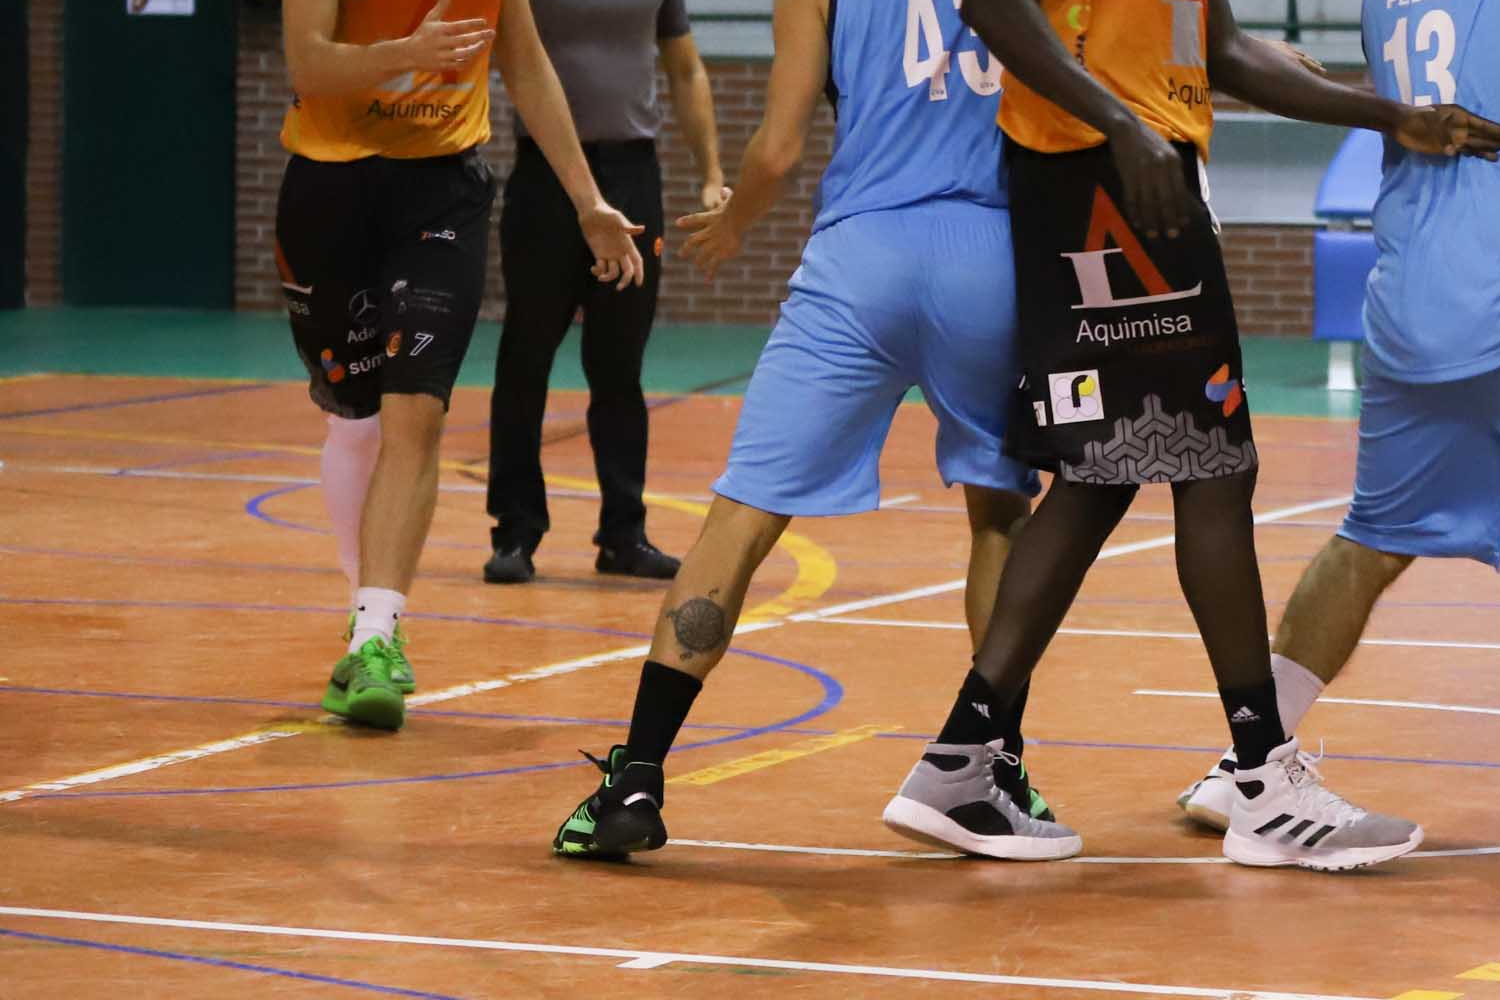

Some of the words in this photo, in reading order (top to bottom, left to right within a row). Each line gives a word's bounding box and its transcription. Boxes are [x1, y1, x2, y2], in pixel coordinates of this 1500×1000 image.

[1383, 9, 1457, 110] 13
[409, 332, 434, 357] 7
[1075, 313, 1193, 347] Aquimisa
